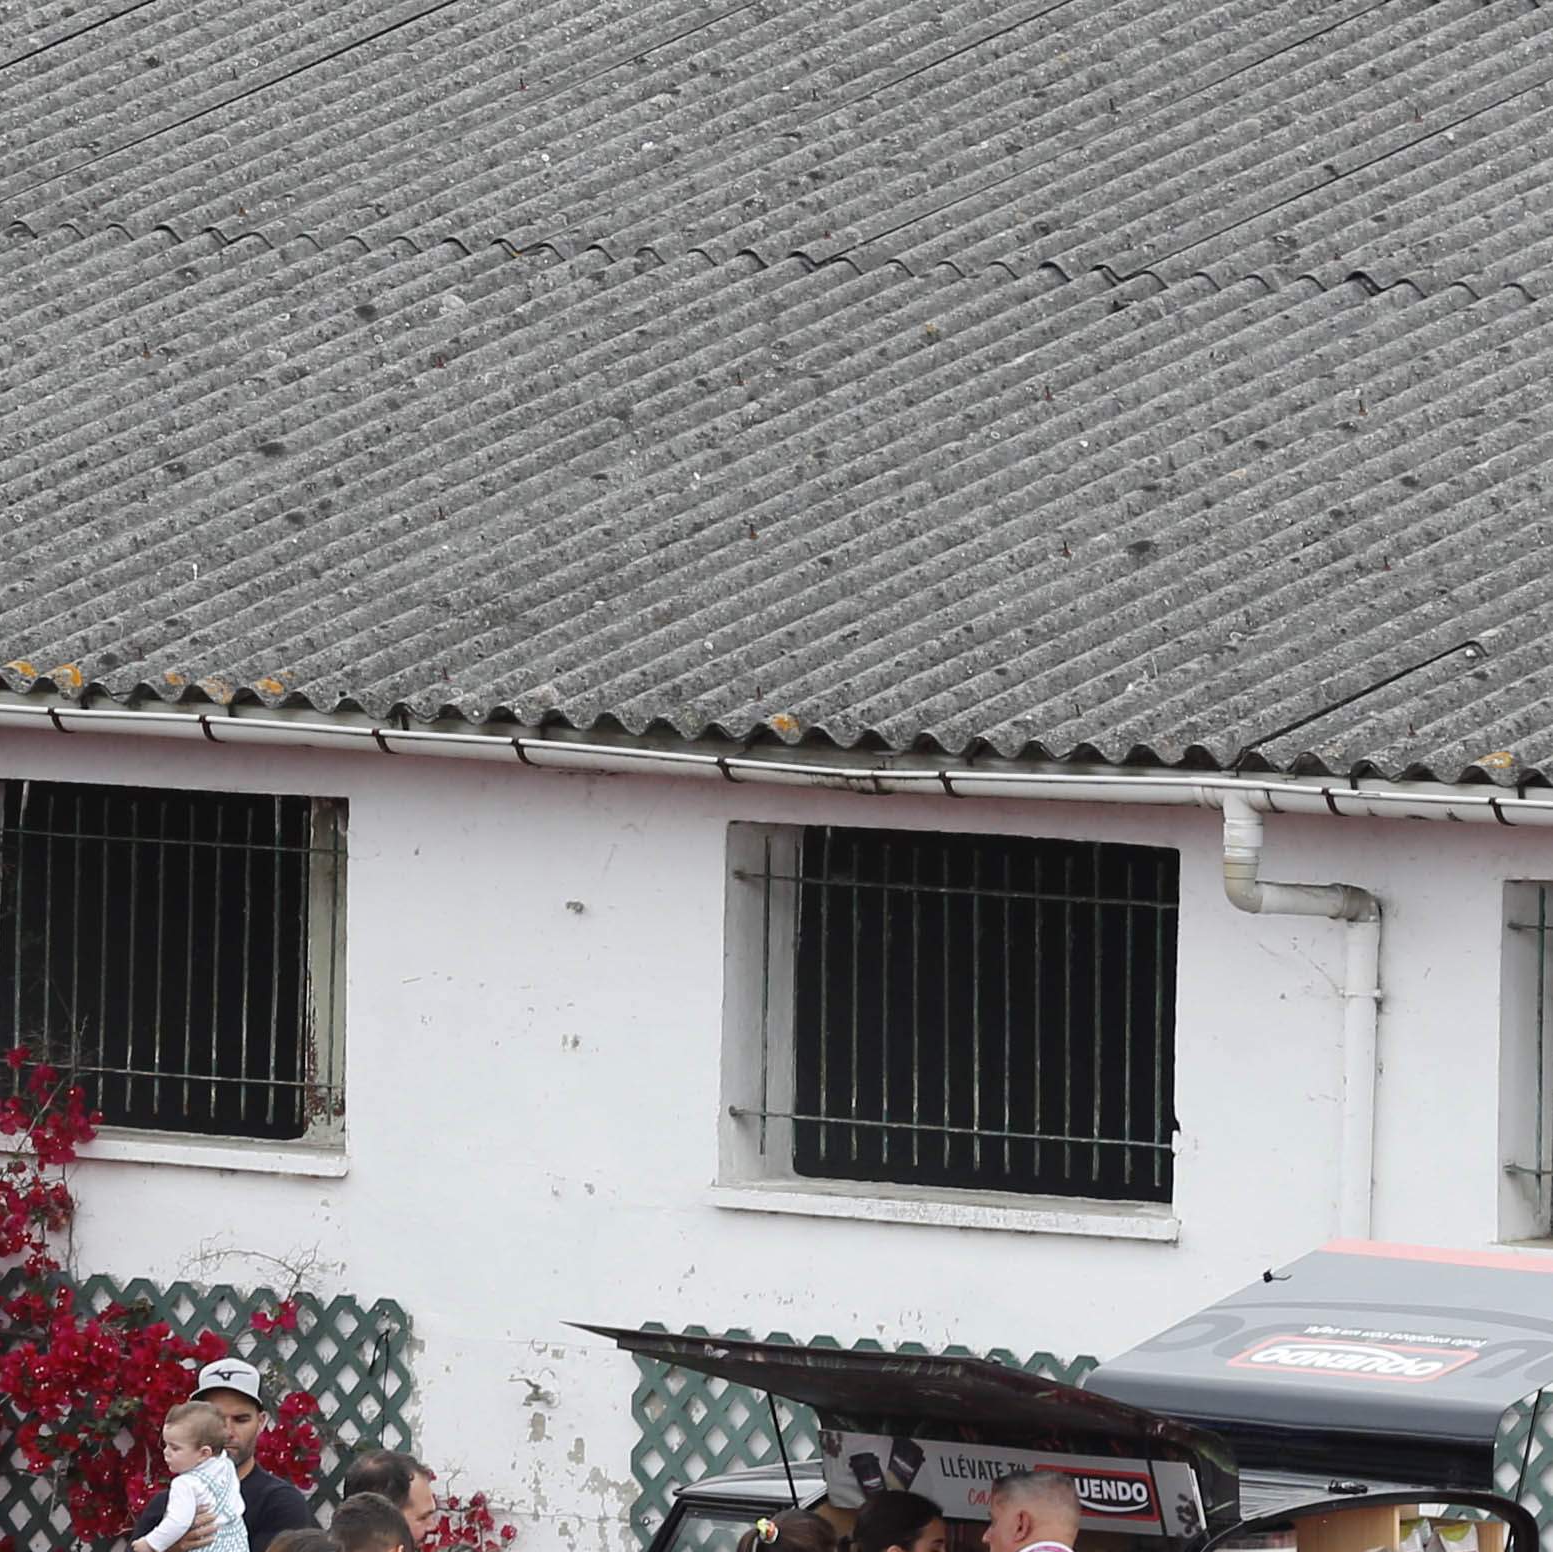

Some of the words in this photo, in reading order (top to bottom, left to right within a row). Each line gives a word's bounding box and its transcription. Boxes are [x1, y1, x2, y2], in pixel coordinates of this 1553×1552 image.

[1251, 1344, 1444, 1377] OQUENDO
[940, 1454, 1004, 1480] LLÉVATE
[1073, 1477, 1148, 1509] UENDO
